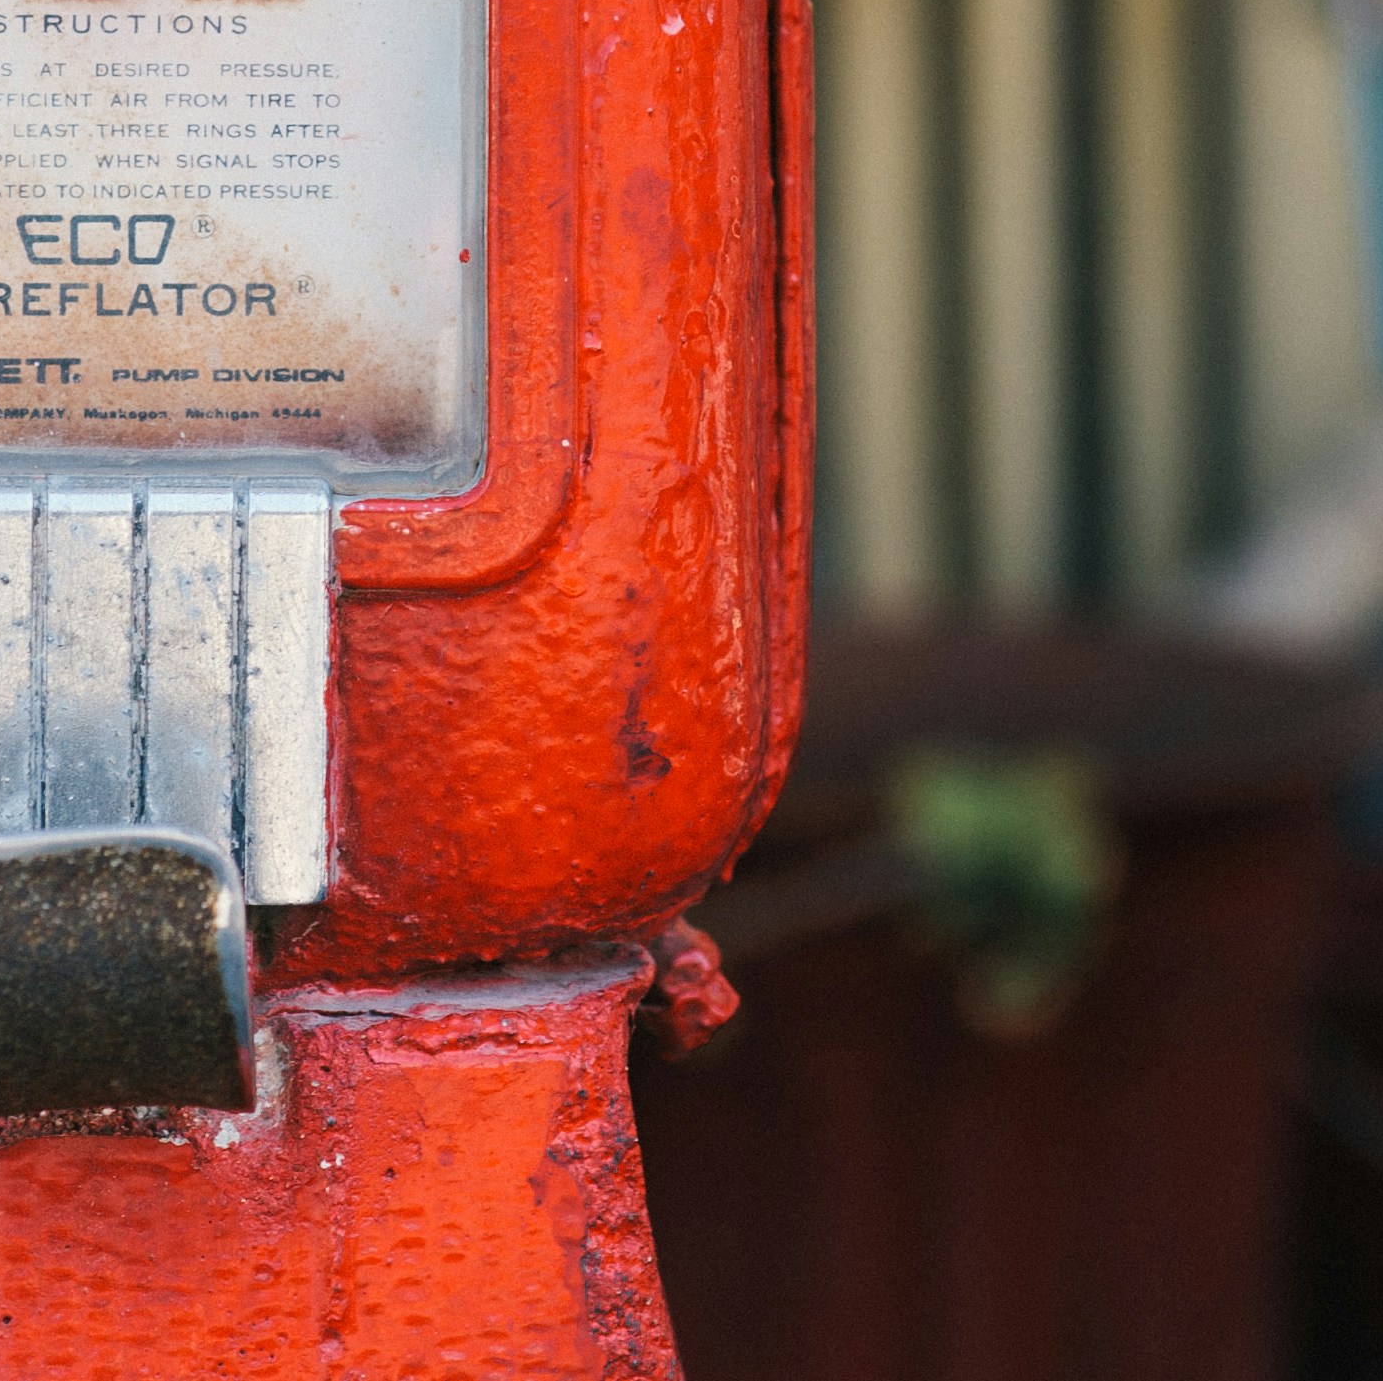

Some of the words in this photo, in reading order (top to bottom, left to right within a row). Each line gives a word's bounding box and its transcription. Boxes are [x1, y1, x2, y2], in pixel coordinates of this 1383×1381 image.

[40, 63, 67, 78] AT
[95, 63, 190, 78] DESIRED
[110, 93, 148, 109] AIR
[165, 93, 228, 109] FROM
[245, 93, 296, 109] TIRE
[313, 93, 341, 109] TO
[13, 123, 80, 139] LEAST
[96, 123, 169, 139] THREE
[187, 123, 257, 139] RINGS
[270, 123, 340, 139] AFTER
[96, 154, 160, 169] WHEN
[176, 154, 257, 169] SIGNAL
[272, 154, 341, 169] STOPS
[56, 184, 84, 199] TO
[93, 184, 211, 199] INDICATED
[220, 184, 339, 200] PRESSURE.
[17, 214, 176, 265] ECO
[112, 369, 199, 382] PUMP
[212, 368, 345, 382] DIVISION
[185, 407, 259, 420] Michigan
[272, 407, 321, 419] 49444
